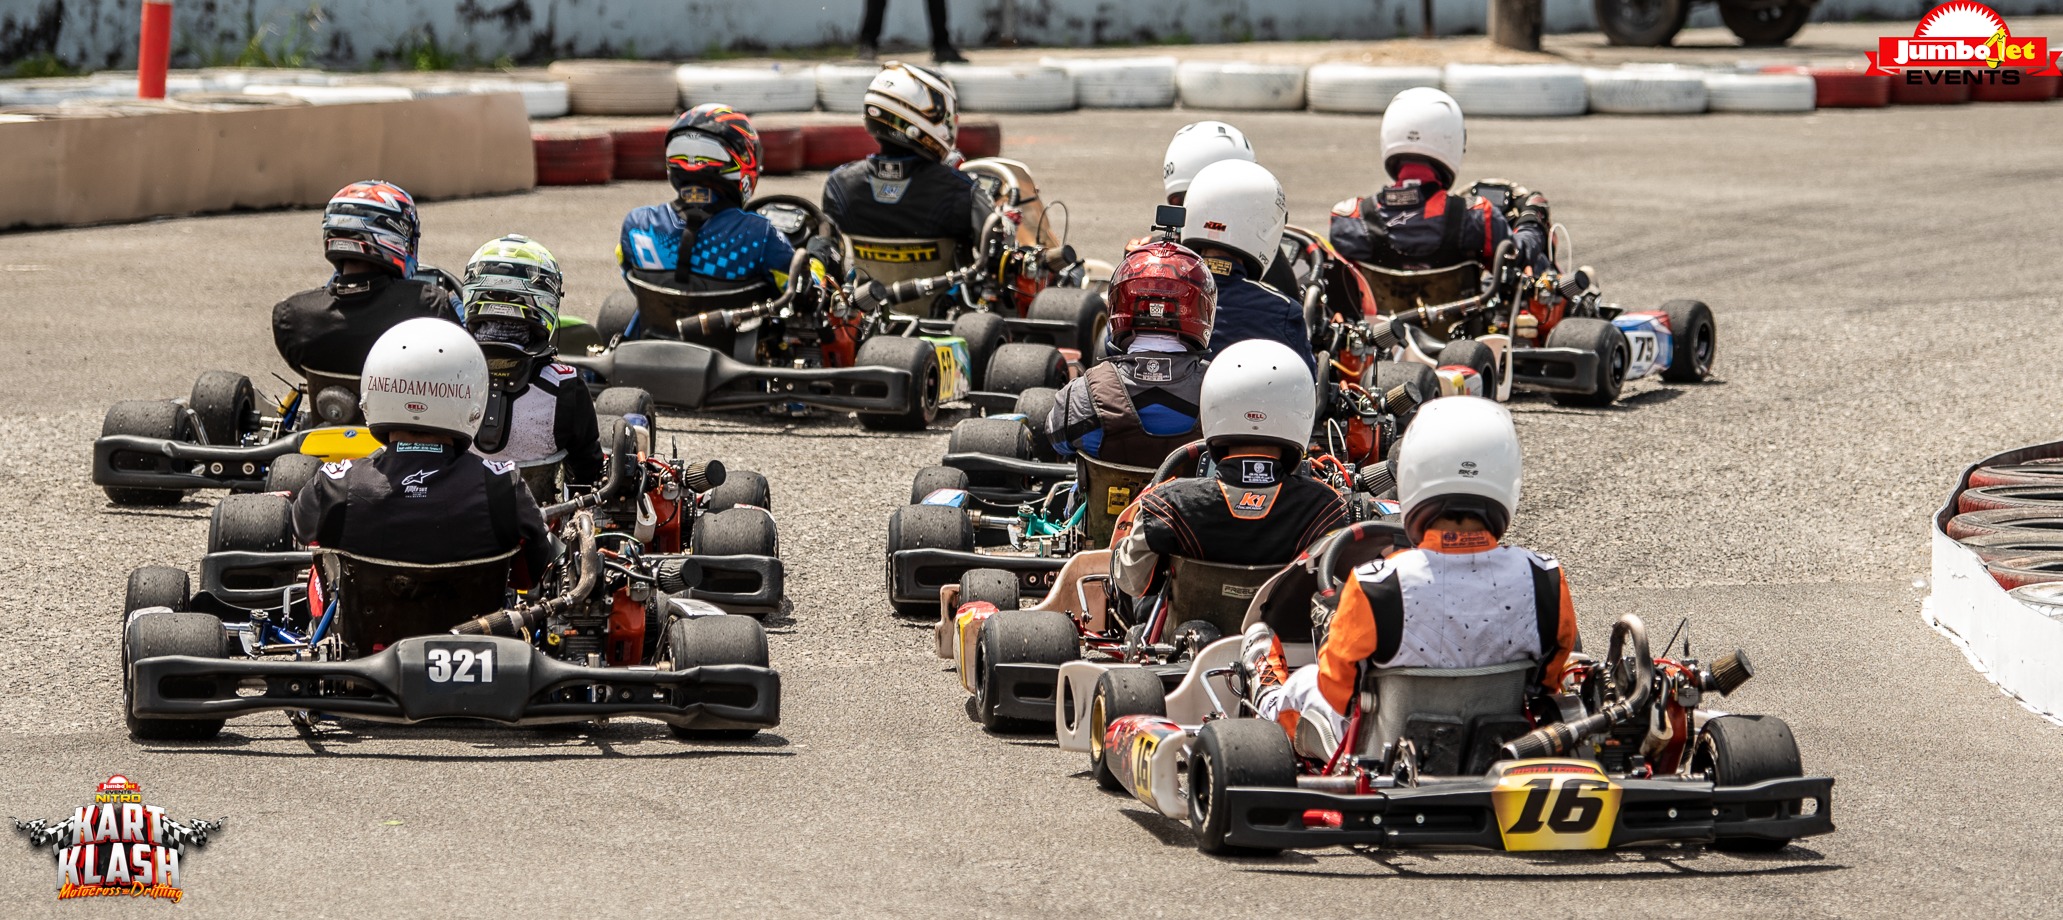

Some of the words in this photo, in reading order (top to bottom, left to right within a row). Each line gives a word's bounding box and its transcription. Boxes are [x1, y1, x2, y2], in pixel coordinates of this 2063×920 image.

[428, 648, 493, 683] 321
[1137, 736, 1154, 791] 16
[1505, 778, 1610, 834] 16
